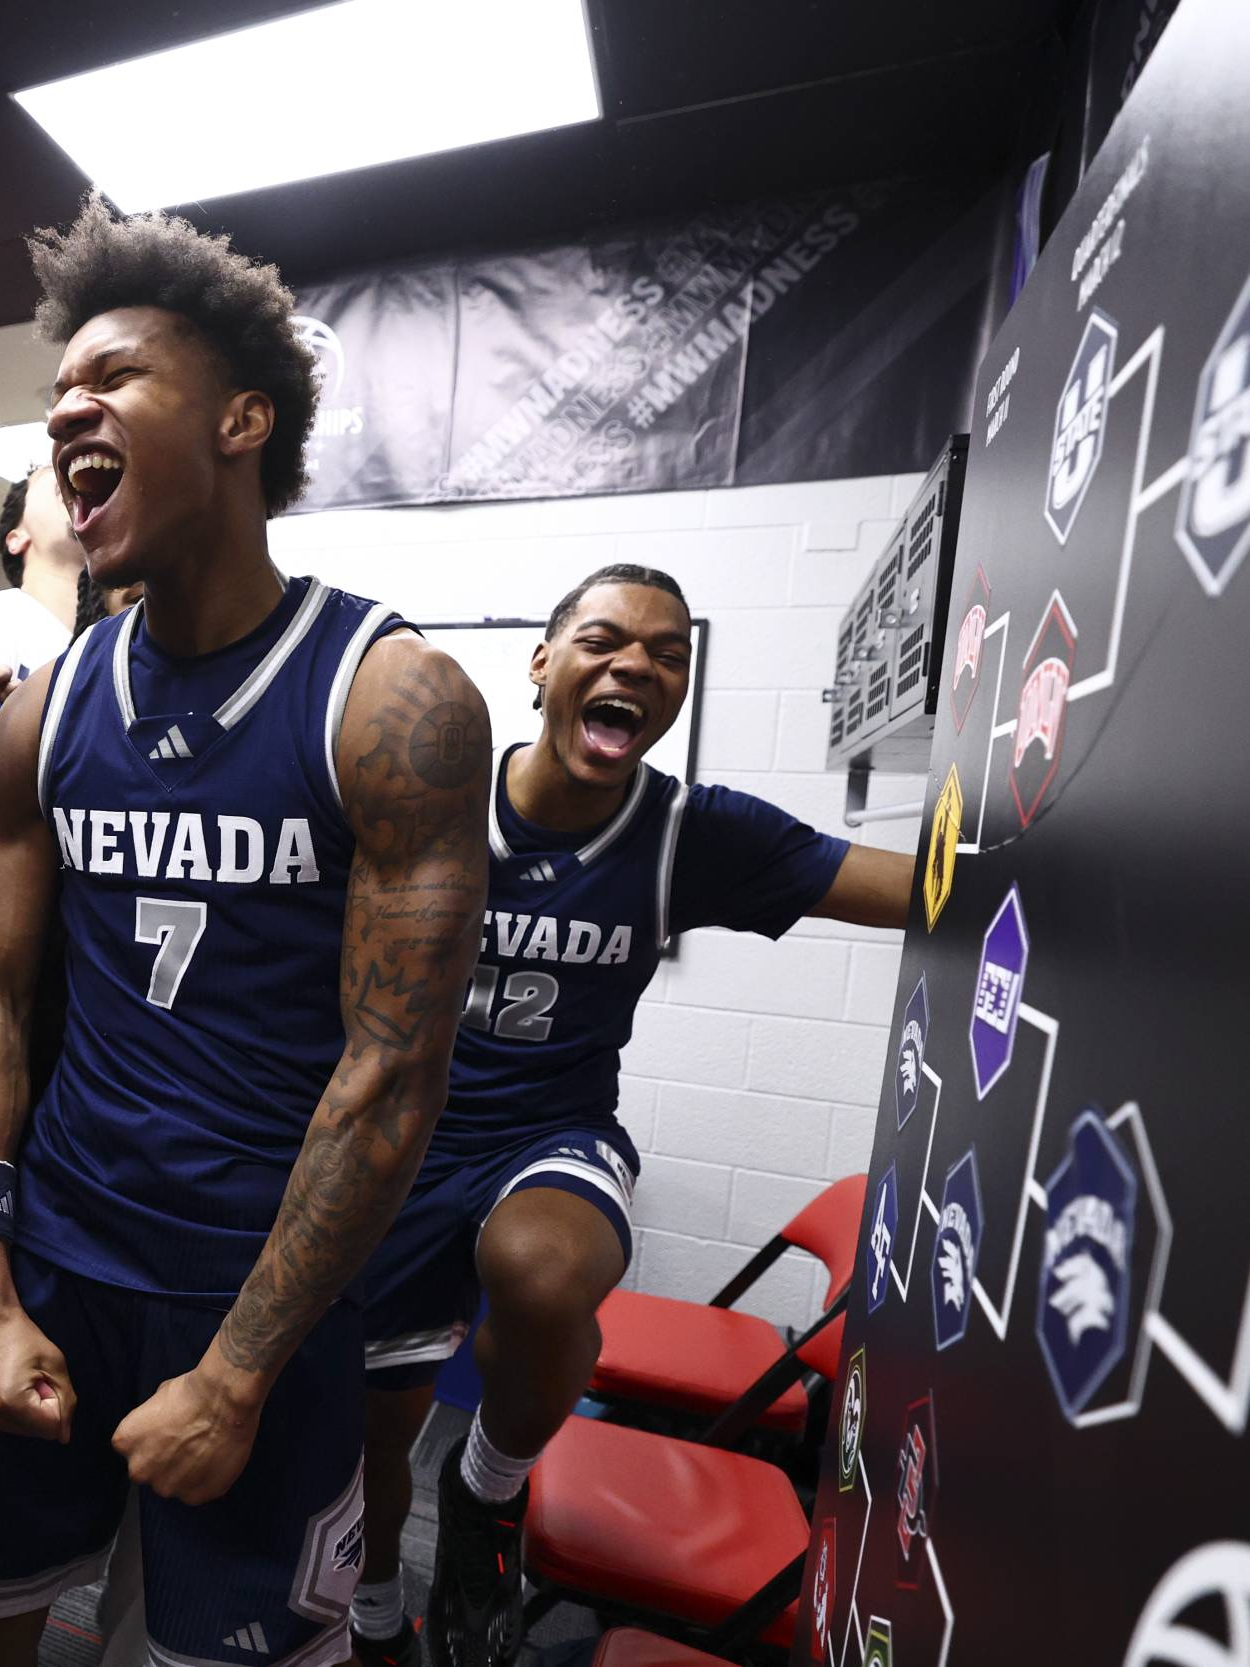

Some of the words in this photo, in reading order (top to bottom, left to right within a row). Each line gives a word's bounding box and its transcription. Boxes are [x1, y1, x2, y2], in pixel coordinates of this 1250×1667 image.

[627, 205, 859, 429] #MWMADNESS
[457, 276, 664, 482] #MWMADNESS
[53, 807, 320, 884] NEVADA
[134, 896, 208, 1010] 7
[480, 910, 633, 965] VADA
